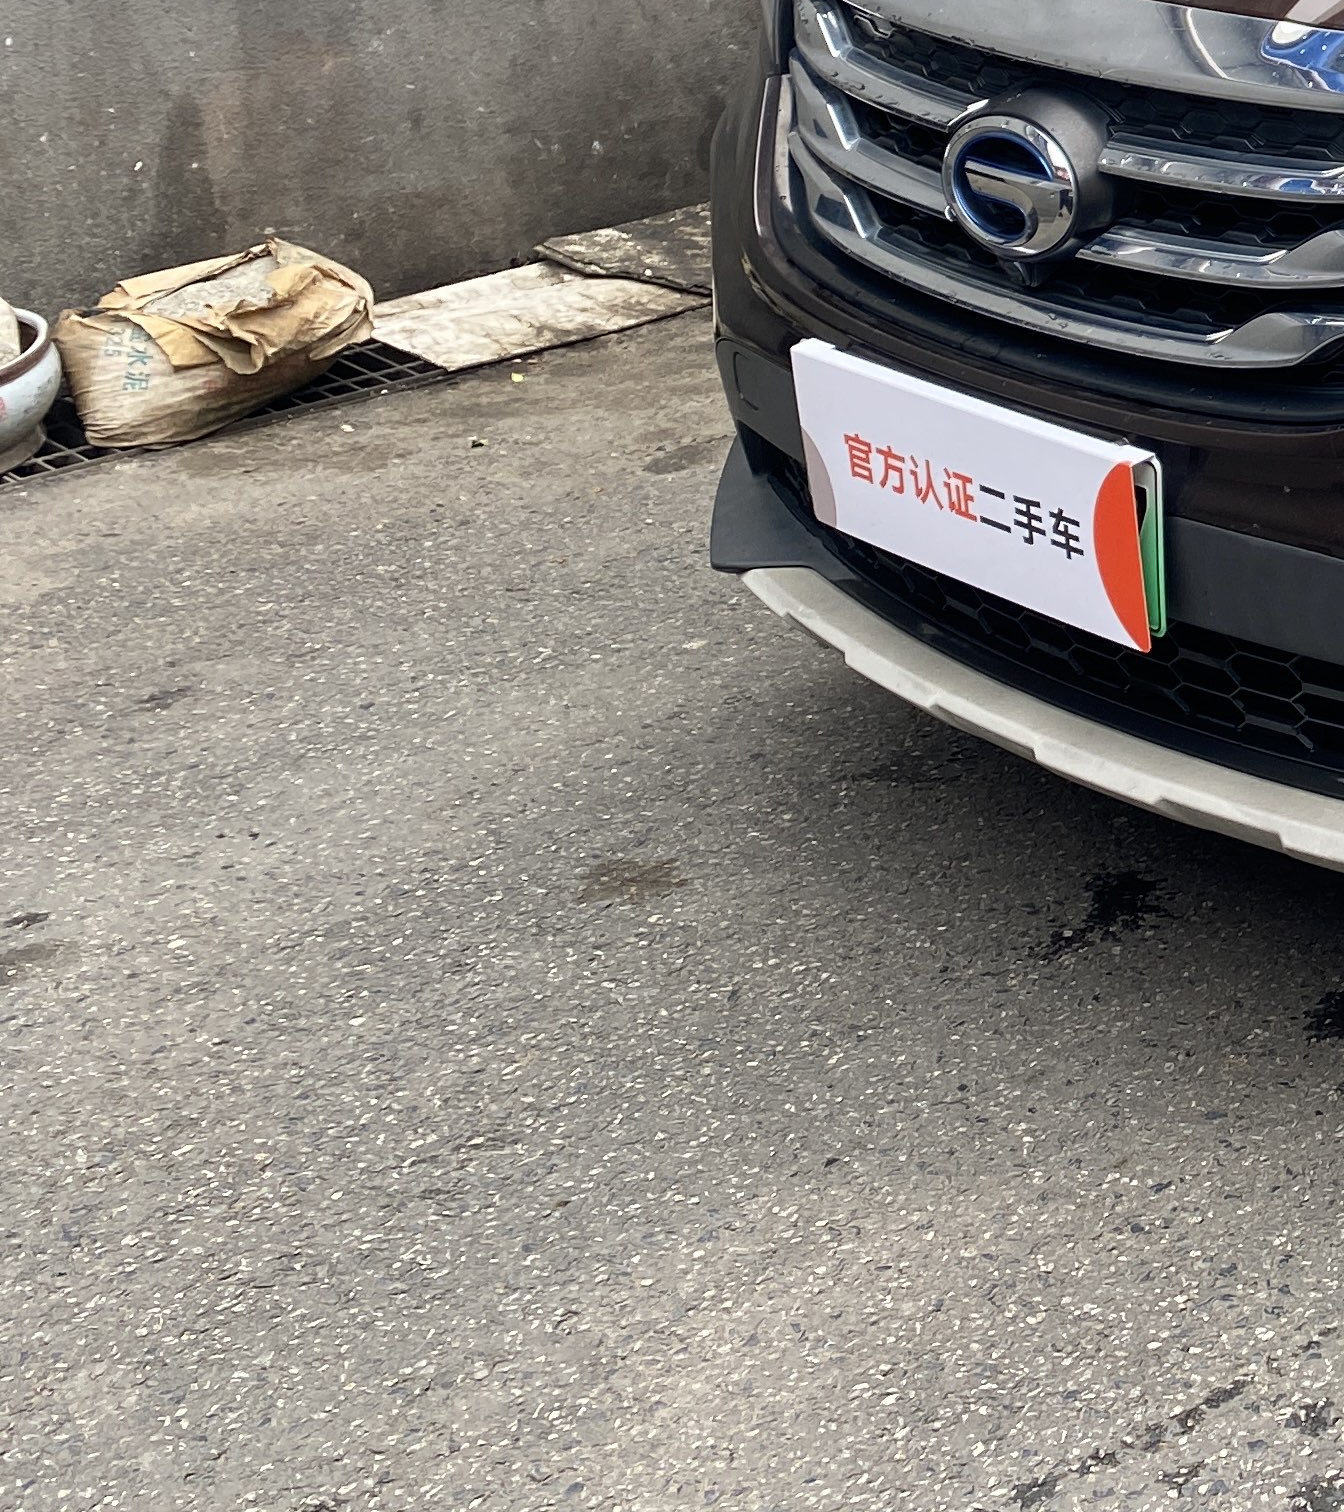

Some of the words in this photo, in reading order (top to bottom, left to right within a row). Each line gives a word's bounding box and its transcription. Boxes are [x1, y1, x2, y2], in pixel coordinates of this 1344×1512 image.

[843, 433, 1085, 560] 官方认证二手车
